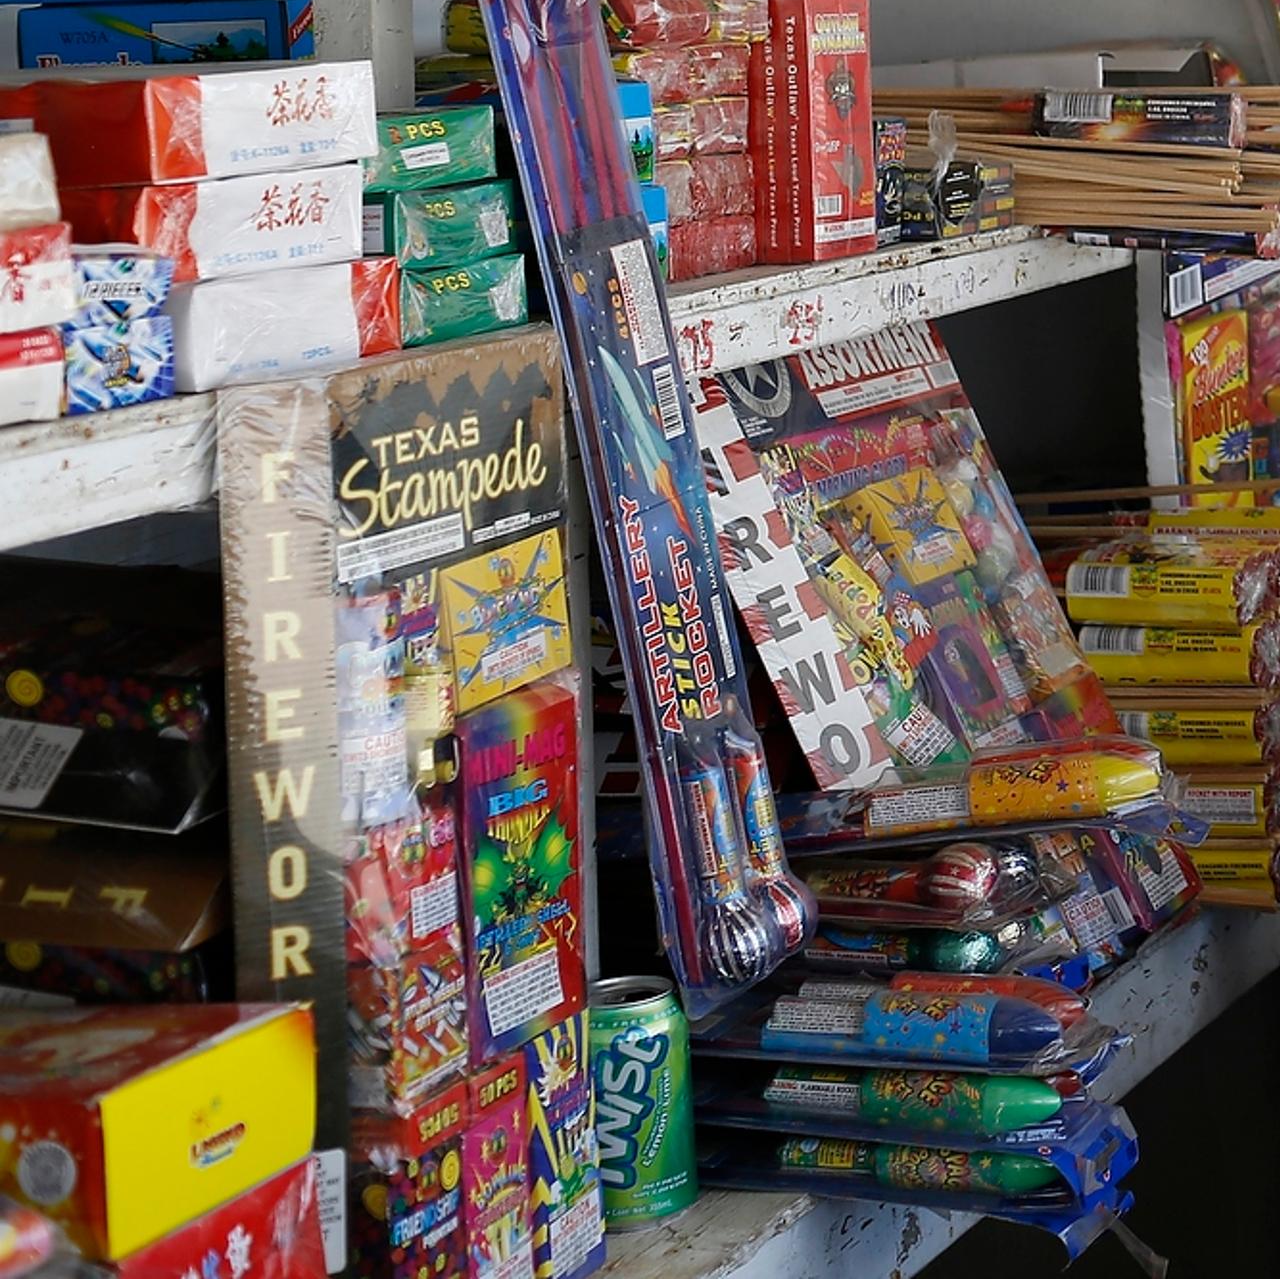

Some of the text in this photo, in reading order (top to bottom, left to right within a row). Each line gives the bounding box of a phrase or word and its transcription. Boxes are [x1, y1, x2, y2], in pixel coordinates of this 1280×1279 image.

[405, 120, 445, 139] PCS
[432, 272, 471, 294] PCS
[800, 320, 940, 390] ASSORTMENT
[371, 416, 480, 469] TEXAS
[338, 418, 547, 538] Stampede
[620, 495, 684, 735] ARTILLERY
[667, 535, 722, 719] ROCKET
[660, 602, 701, 720] STICK
[467, 723, 566, 782] MINI-MAG
[487, 778, 549, 818] BIG
[496, 1069, 518, 1097] PCS
